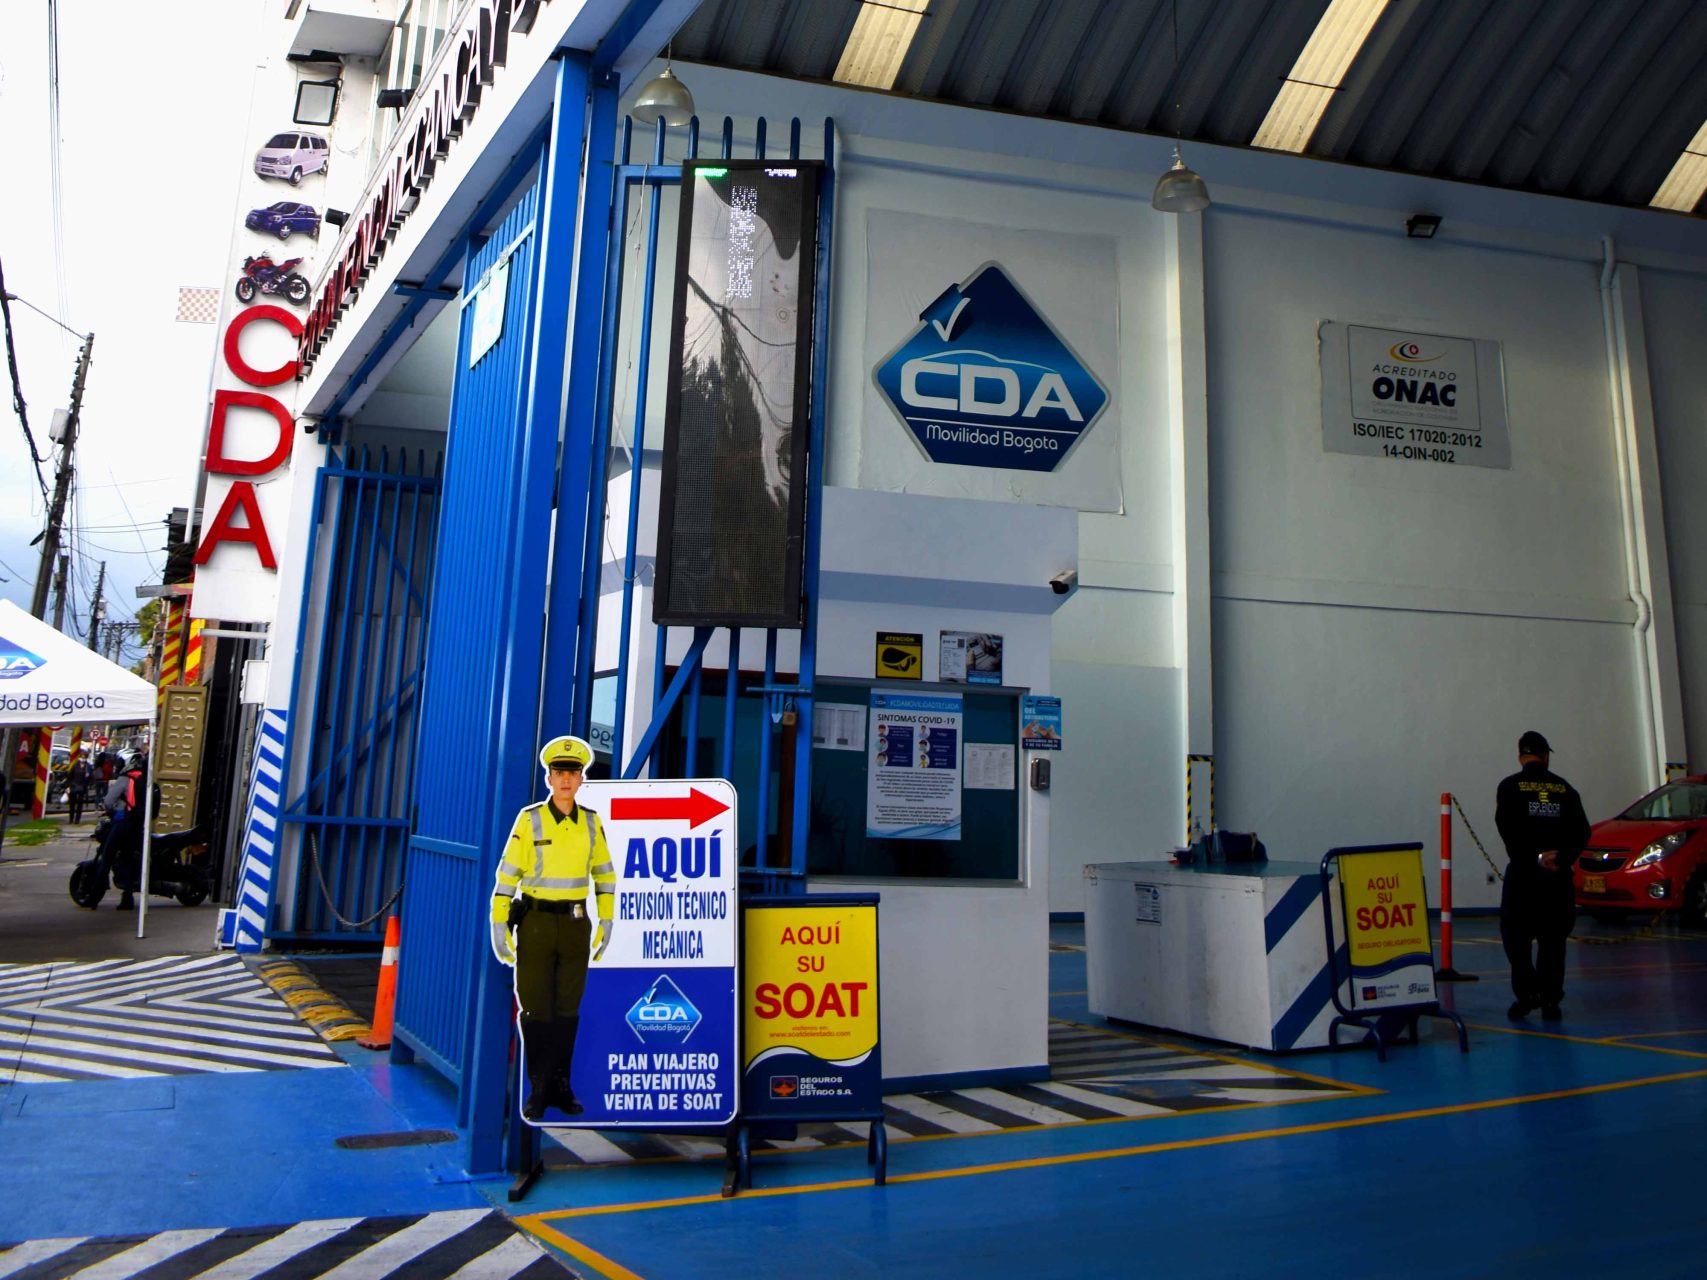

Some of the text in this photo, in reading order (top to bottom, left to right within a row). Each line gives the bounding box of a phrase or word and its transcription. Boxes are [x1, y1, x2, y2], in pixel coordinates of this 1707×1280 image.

[1372, 364, 1457, 382] ACREDITADO
[901, 359, 1084, 422] CDA
[1372, 376, 1457, 407] ONAC
[193, 304, 305, 570] CDA
[926, 424, 1058, 454] Movilidad Bogota
[1353, 422, 1482, 448] ISO/IEC 17020:2012
[1383, 444, 1456, 463] 14-OIN-002
[36, 693, 105, 717] Bogota
[877, 713, 916, 723] SINTOMAS
[918, 715, 942, 724] COVID
[624, 830, 722, 883] AQUÍ
[1367, 873, 1400, 891] AQUÍ
[621, 884, 727, 921] REVISIÓN TÉCNICO
[1377, 893, 1393, 904] SU
[1356, 903, 1416, 931] SOAT
[642, 924, 704, 960] MECÁNICA
[780, 921, 840, 946] AQUÍ
[797, 956, 825, 973] SU
[754, 982, 867, 1020] SOAT
[638, 1006, 689, 1021] CDA
[608, 1052, 719, 1072] PLAN VIAJERO
[611, 1073, 716, 1091] PREVENTIVAS
[604, 1092, 723, 1111] VENTA DE SOAT
